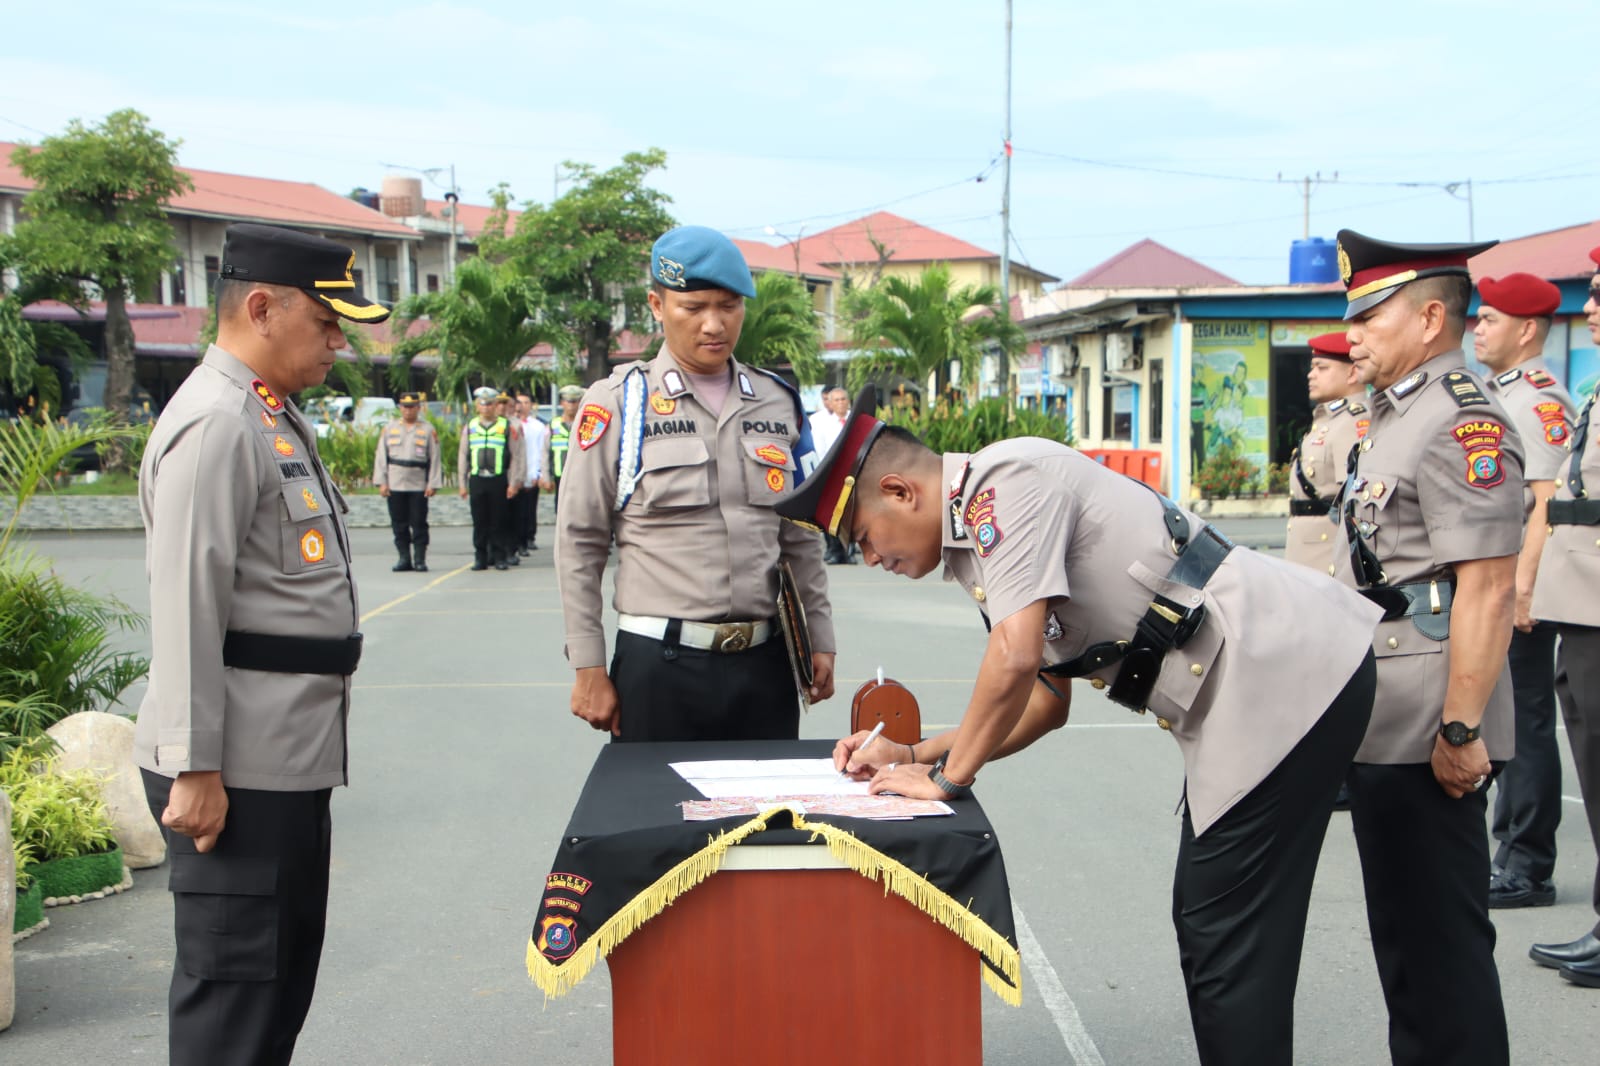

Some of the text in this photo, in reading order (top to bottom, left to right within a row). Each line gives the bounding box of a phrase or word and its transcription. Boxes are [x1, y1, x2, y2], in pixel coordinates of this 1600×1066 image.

[742, 421, 789, 435] POLRI
[1456, 422, 1500, 437] POLDA
[548, 875, 588, 888] POLRES
